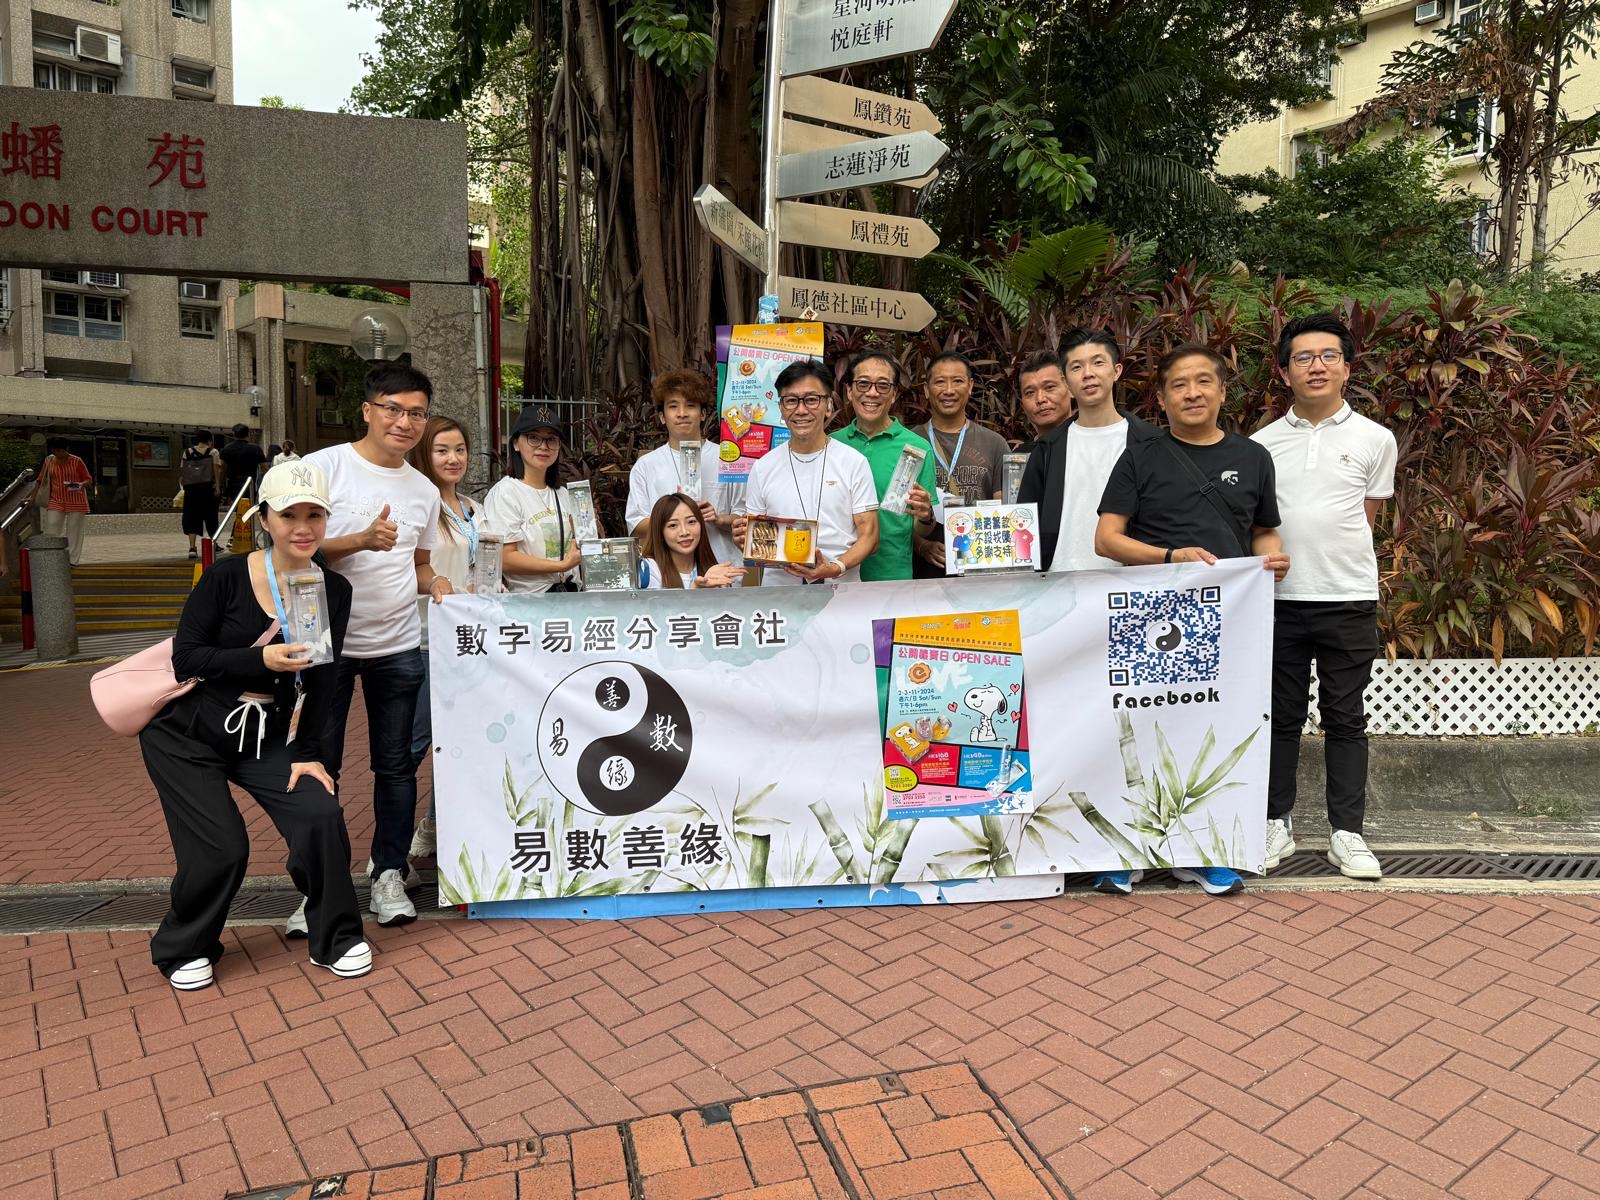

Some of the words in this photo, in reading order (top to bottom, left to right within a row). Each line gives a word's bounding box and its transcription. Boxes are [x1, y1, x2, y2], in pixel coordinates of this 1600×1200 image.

[853, 97, 912, 131] 鳳鑽苑
[824, 143, 911, 181] 志蓮淨苑
[91, 205, 209, 237] COURT
[850, 219, 910, 248] 鳳禮苑
[791, 287, 907, 321] 鳳德社區中心
[975, 545, 1012, 559] 多謝支持
[456, 612, 786, 656] 數字易經分享會社
[952, 652, 981, 665] OPEN
[983, 654, 1012, 667] SALE
[650, 713, 684, 753] 數
[510, 822, 724, 873] 易數善緣
